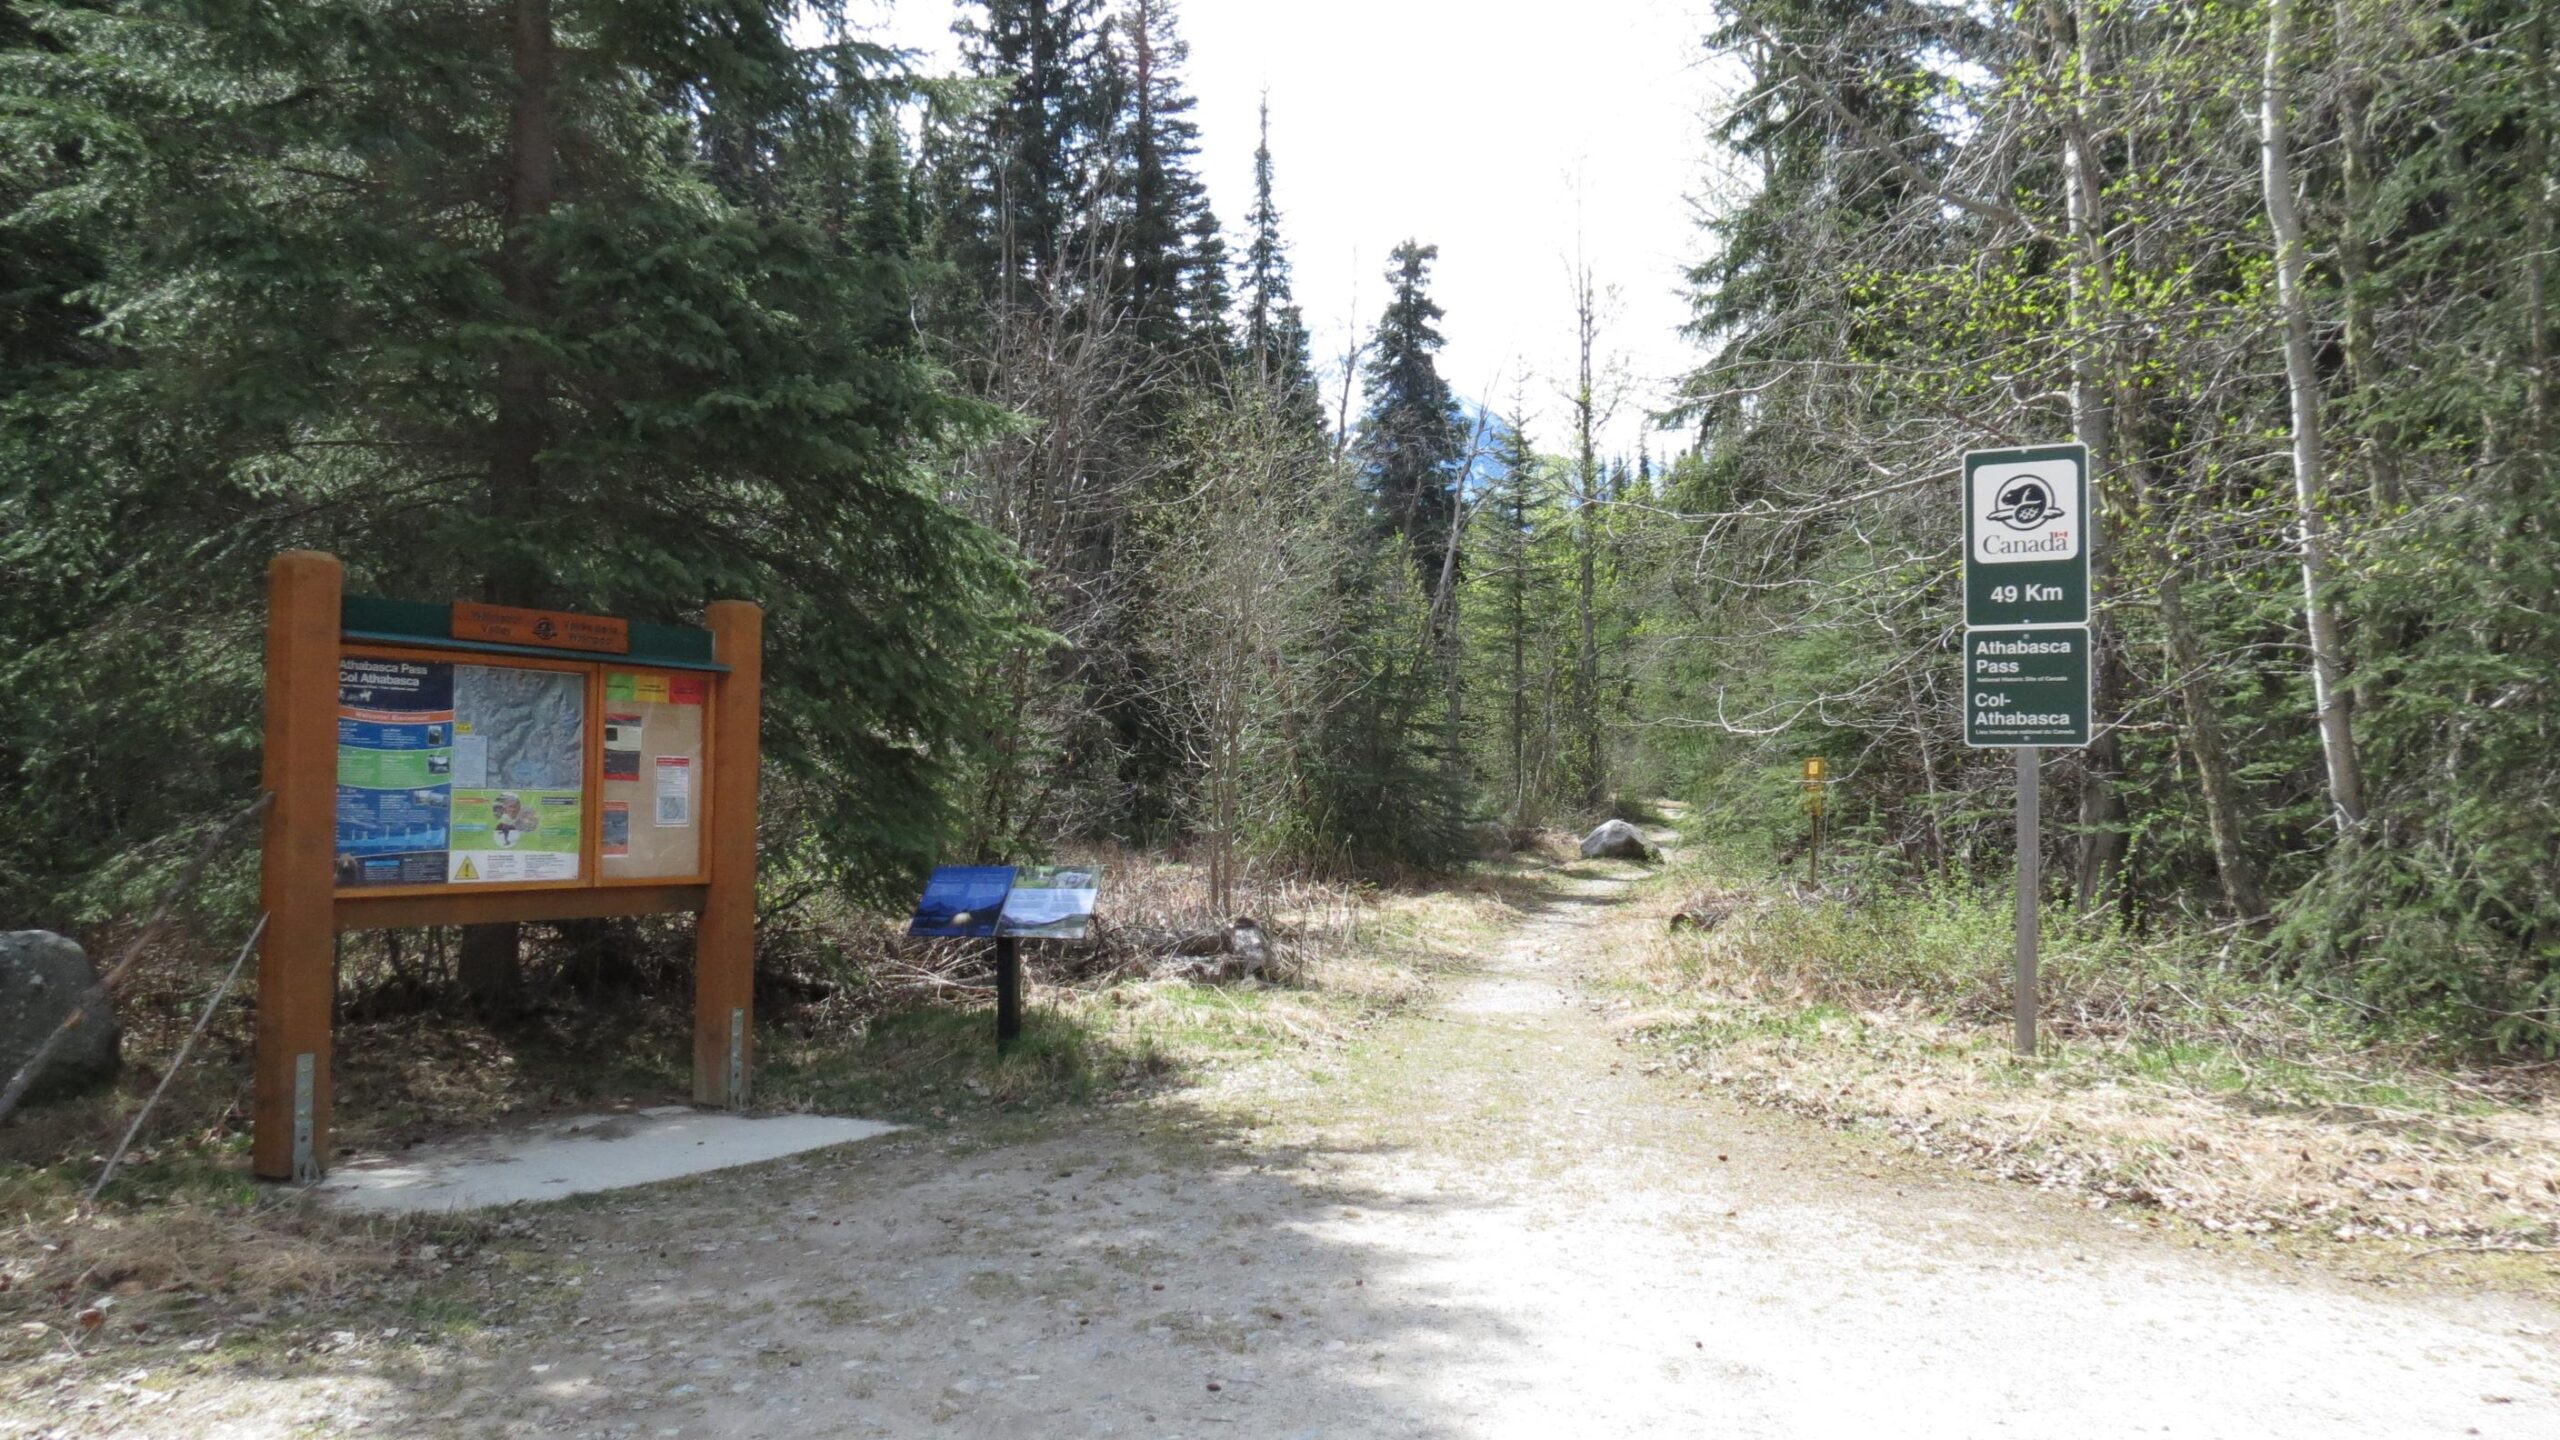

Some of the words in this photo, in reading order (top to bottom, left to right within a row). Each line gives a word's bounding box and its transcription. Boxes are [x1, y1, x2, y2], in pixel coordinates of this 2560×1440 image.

[1982, 532, 2068, 555] Canada
[1990, 585, 2018, 603] 49
[2025, 583, 2063, 602] Km
[1976, 640, 2071, 655] Athabasca
[340, 660, 399, 673] Athabasca
[401, 663, 428, 675] Pass
[1976, 659, 2020, 674] Pass
[339, 671, 358, 682] Col
[360, 673, 420, 687] Athabasca
[1975, 692, 2012, 707] Col-
[1975, 711, 2070, 726] Athabasca
